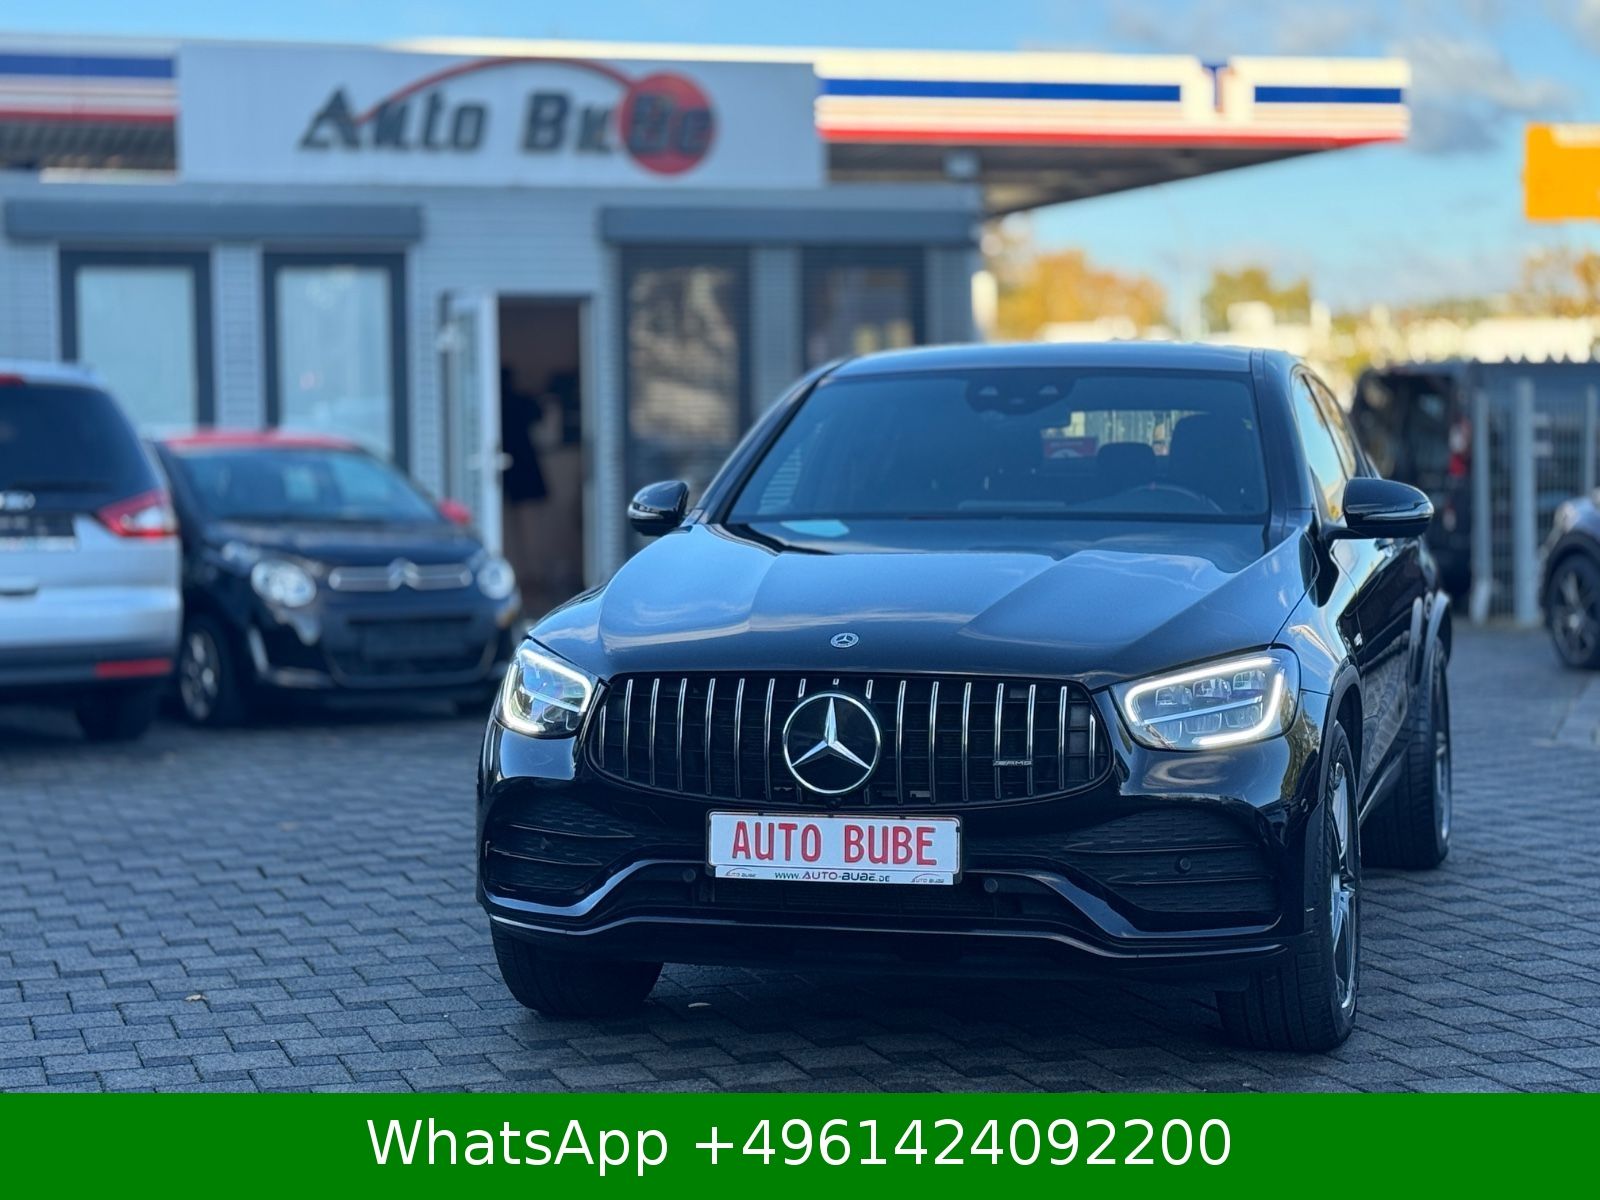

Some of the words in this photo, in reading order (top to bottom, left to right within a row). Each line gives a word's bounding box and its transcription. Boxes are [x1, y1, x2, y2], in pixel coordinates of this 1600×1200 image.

[299, 87, 489, 151] Auto
[732, 821, 822, 862] AUTO
[844, 824, 938, 866] BUBE
